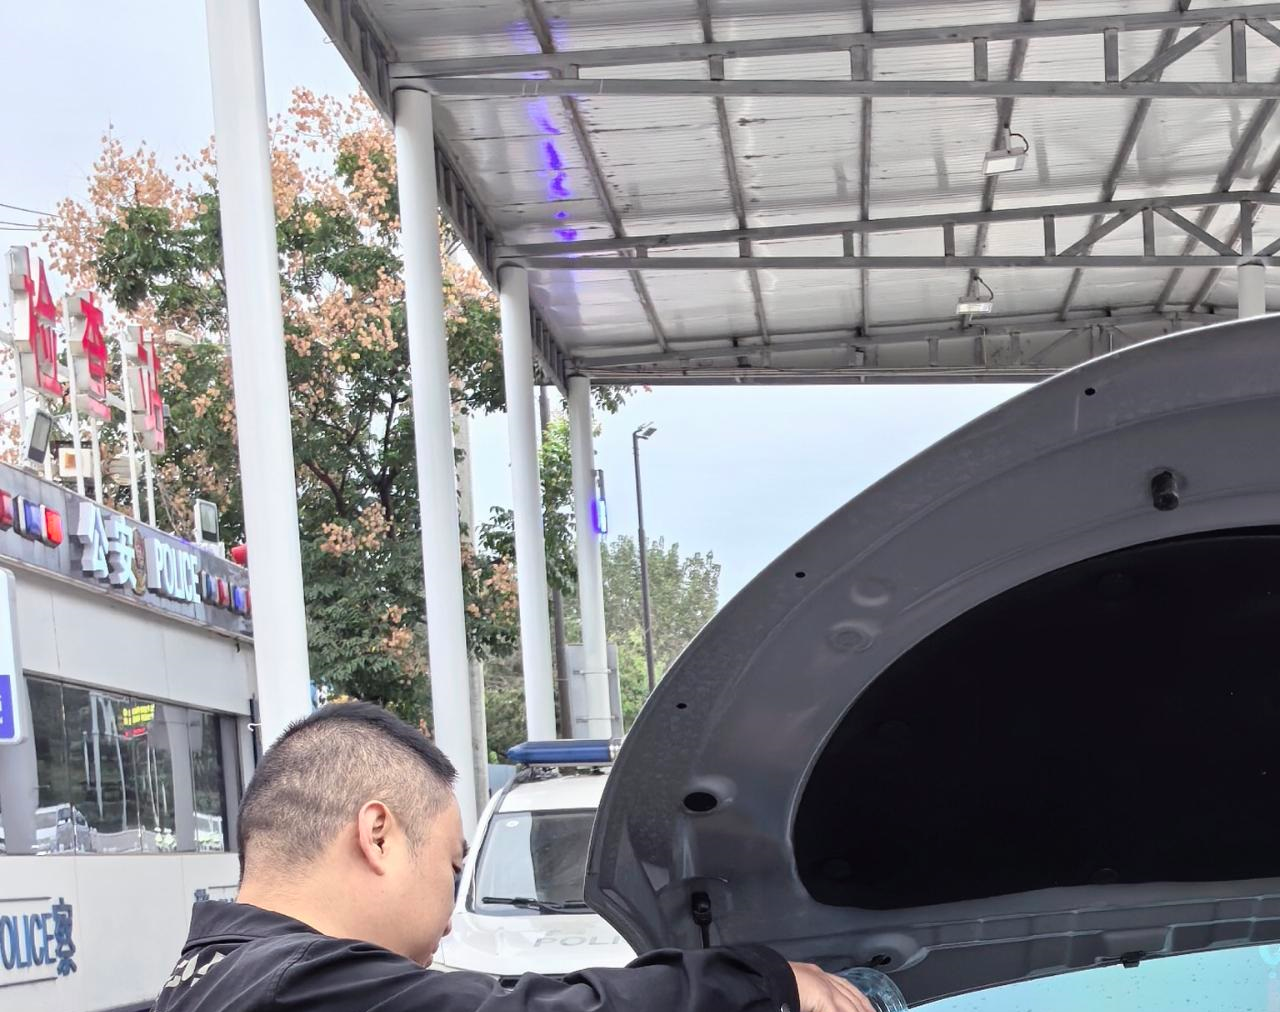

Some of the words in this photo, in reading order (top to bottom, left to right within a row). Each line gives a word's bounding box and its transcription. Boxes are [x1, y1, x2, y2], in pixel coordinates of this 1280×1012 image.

[78, 502, 138, 590] 公安
[148, 538, 201, 604] POLICE
[0, 913, 56, 970] OLICE
